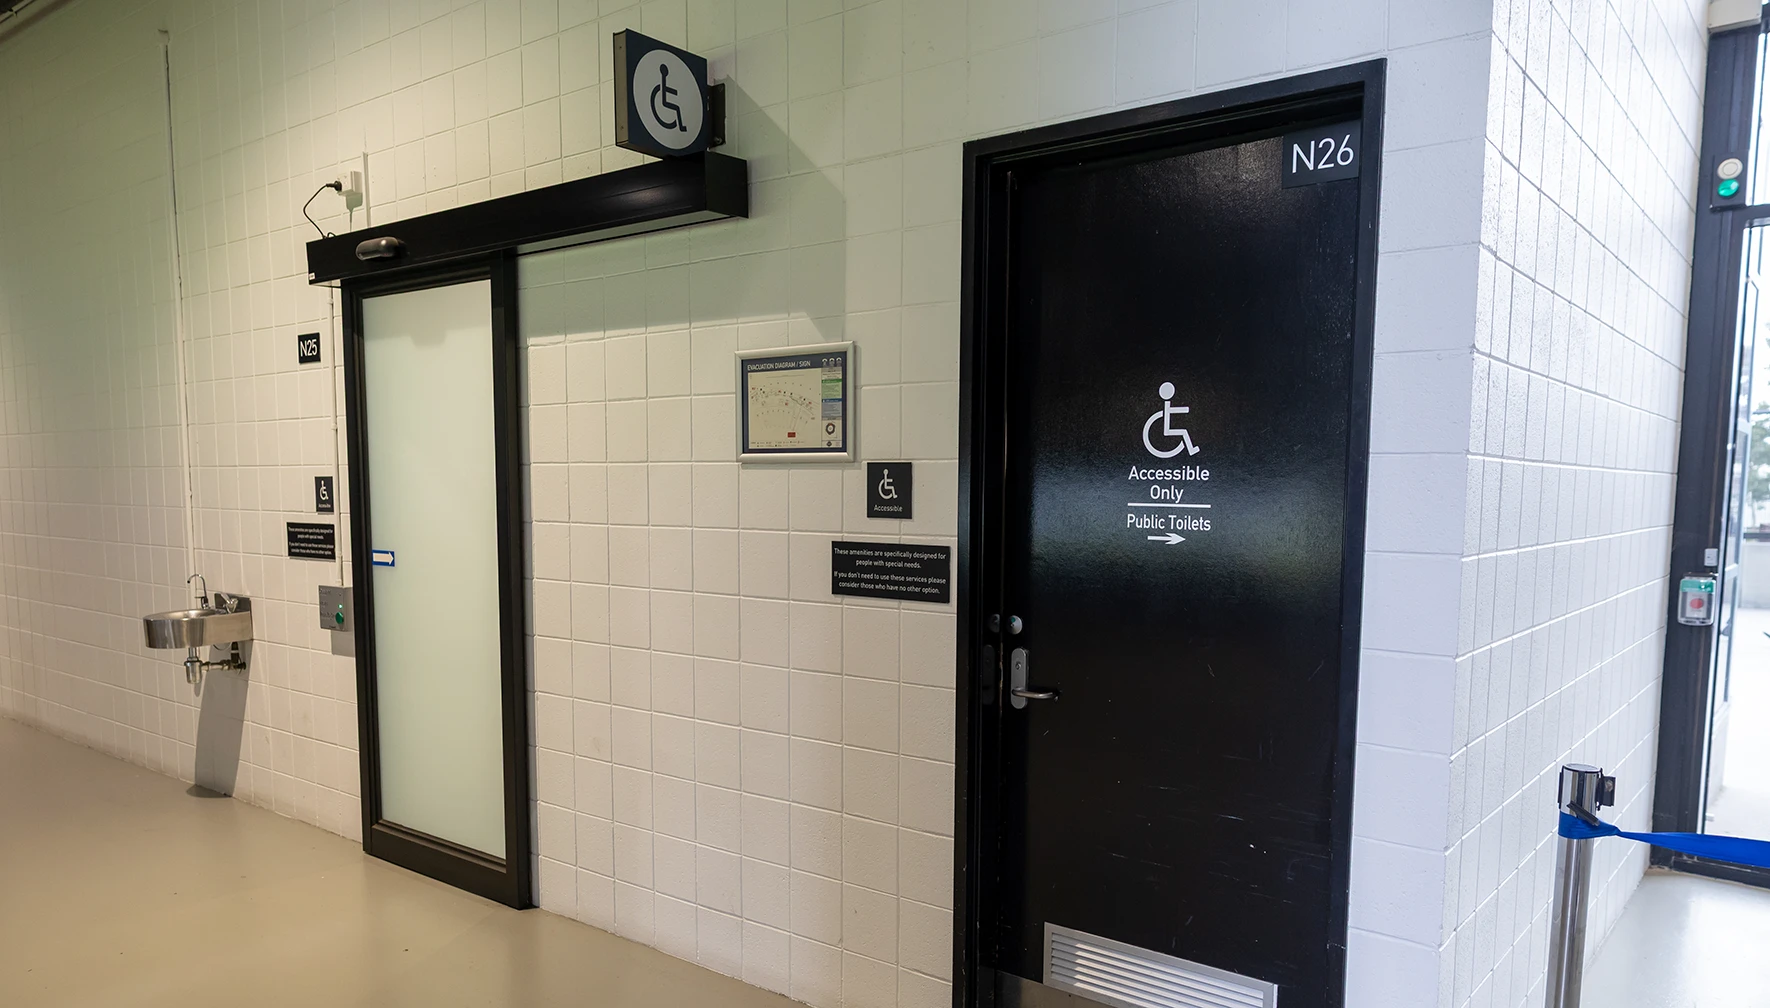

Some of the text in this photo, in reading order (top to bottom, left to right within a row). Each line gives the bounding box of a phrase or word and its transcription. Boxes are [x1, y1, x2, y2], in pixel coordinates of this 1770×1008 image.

[1292, 134, 1354, 173] N26
[300, 339, 318, 357] N25
[747, 363, 774, 371] EVACUATION
[775, 361, 796, 369] DIAGRAM
[1128, 465, 1210, 480] Accessible
[1150, 484, 1184, 503] Only
[873, 504, 903, 512] Accessible
[1127, 513, 1211, 531] Public Toilets
[884, 551, 912, 559] specifically
[913, 552, 938, 560] designed
[886, 583, 899, 591] have
[906, 585, 921, 593] other
